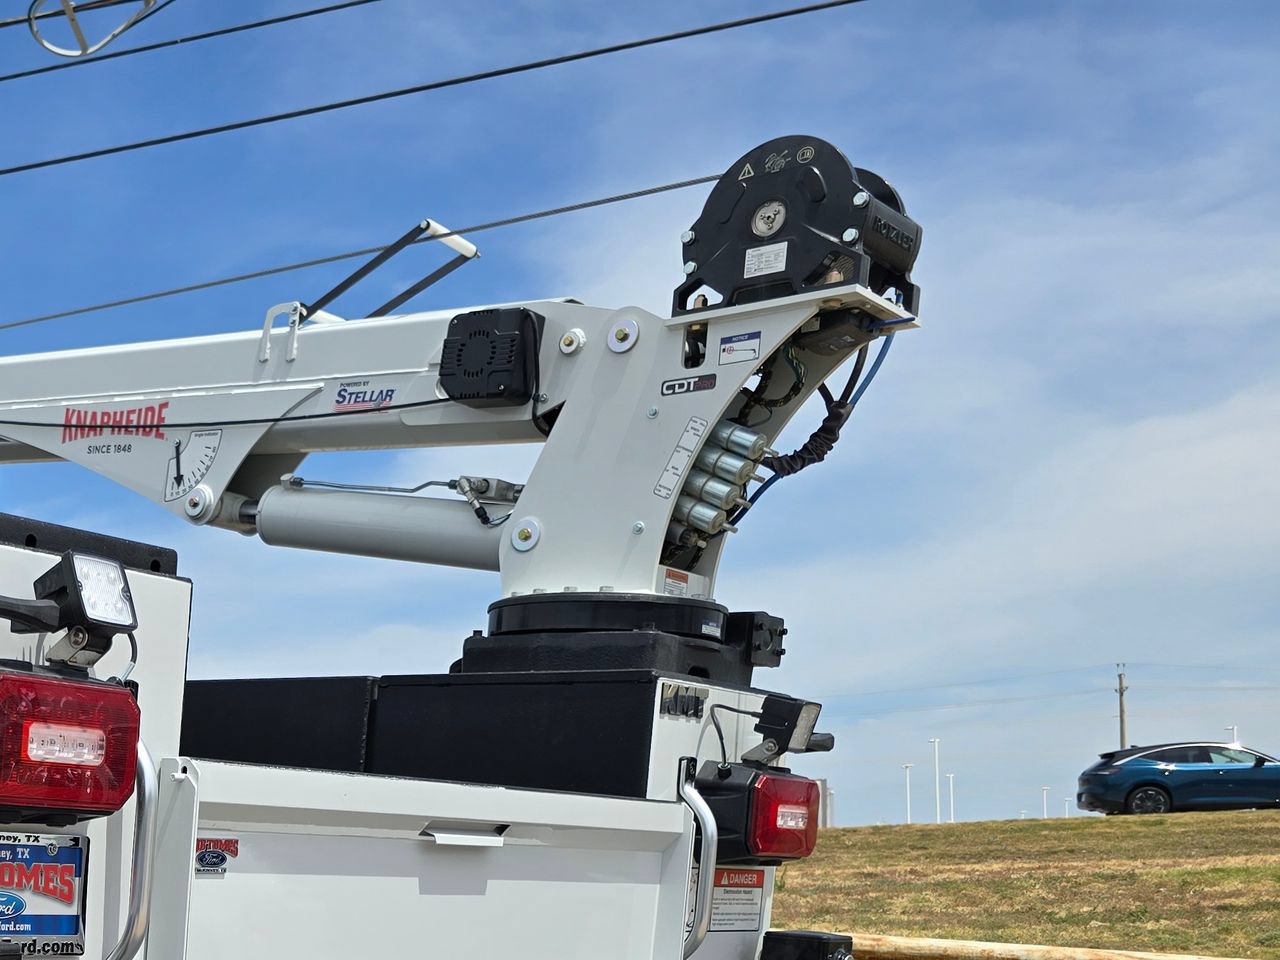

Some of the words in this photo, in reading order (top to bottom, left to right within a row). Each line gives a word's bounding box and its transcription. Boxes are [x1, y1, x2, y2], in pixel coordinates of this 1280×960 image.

[335, 388, 395, 404] STELLAR
[61, 401, 169, 445] KNAPHEIDE
[87, 445, 112, 455] SINCE
[113, 444, 133, 454] 1848
[24, 834, 41, 843] TX
[16, 847, 30, 859] TX
[729, 873, 758, 885] DANGER
